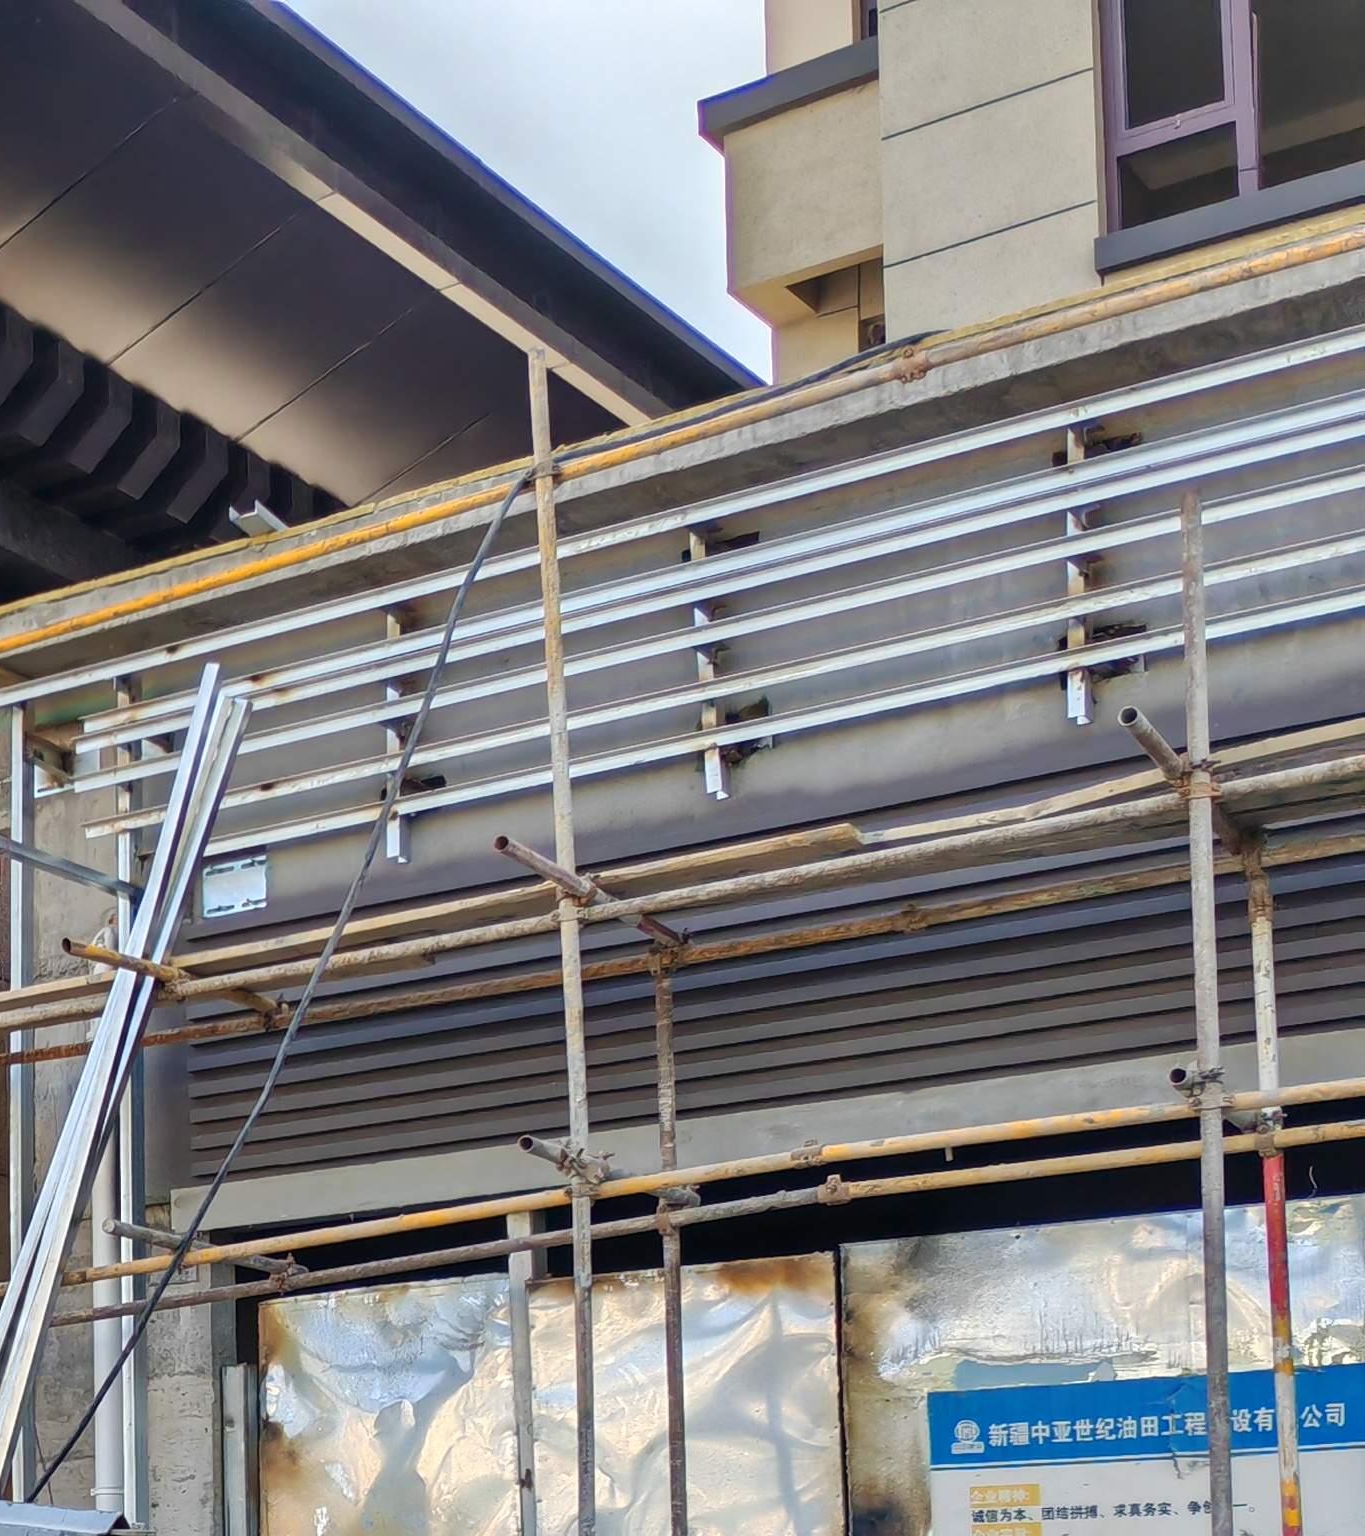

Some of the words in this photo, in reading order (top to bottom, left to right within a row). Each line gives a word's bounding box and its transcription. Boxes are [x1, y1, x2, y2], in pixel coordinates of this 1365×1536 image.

[987, 1402, 1346, 1448] 新疆中亚世纪油田工程设有公司
